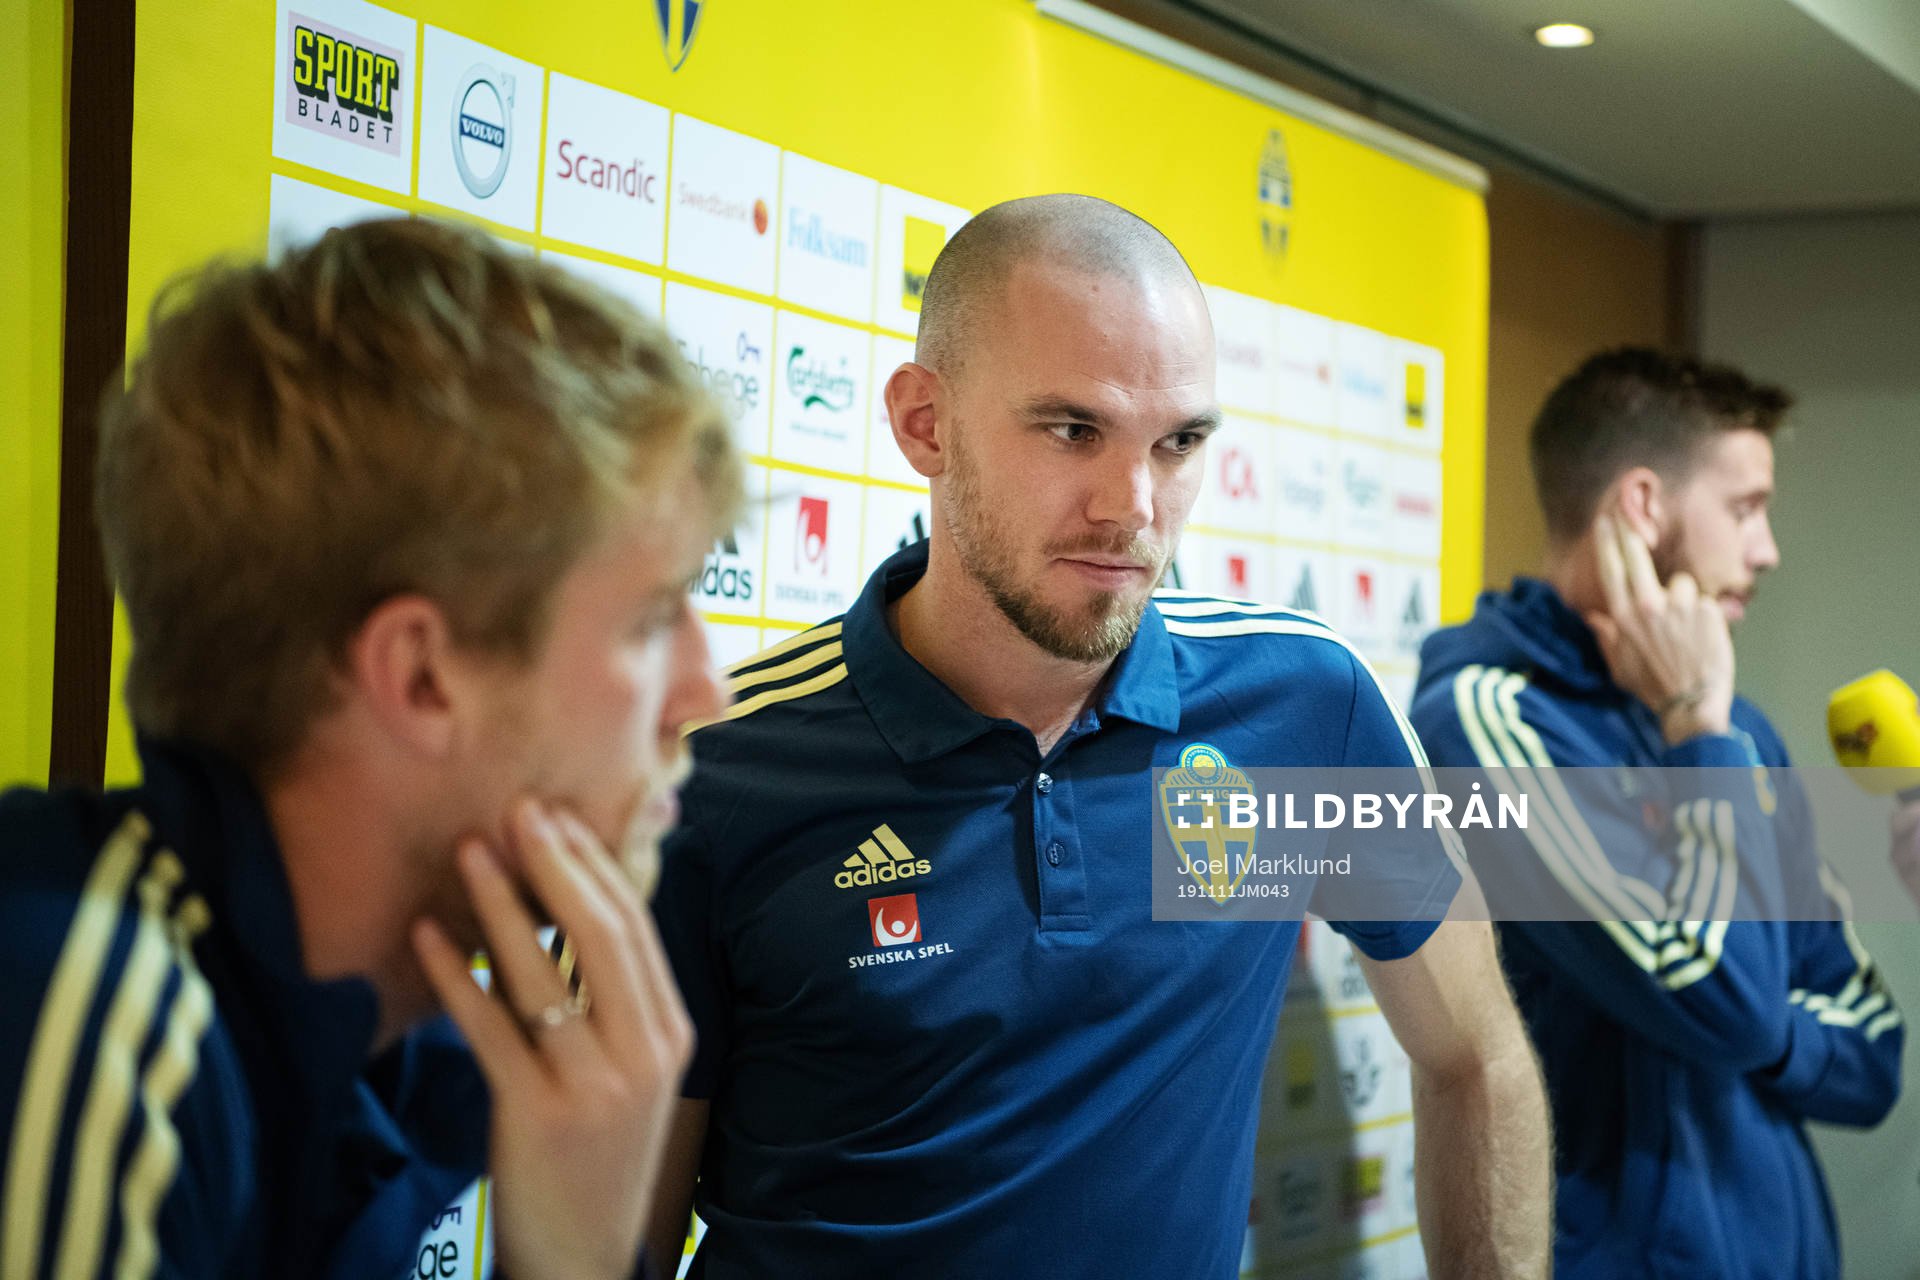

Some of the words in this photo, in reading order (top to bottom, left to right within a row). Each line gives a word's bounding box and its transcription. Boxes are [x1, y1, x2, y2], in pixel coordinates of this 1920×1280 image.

[294, 25, 399, 123] SPORT
[298, 98, 393, 143] BLADET
[461, 116, 504, 146] VOLVO
[557, 139, 656, 204] Scandic
[679, 183, 749, 222] Swedbank
[834, 858, 932, 889] adidas
[848, 950, 915, 969] SVENSKA
[918, 942, 954, 960] SPEL
